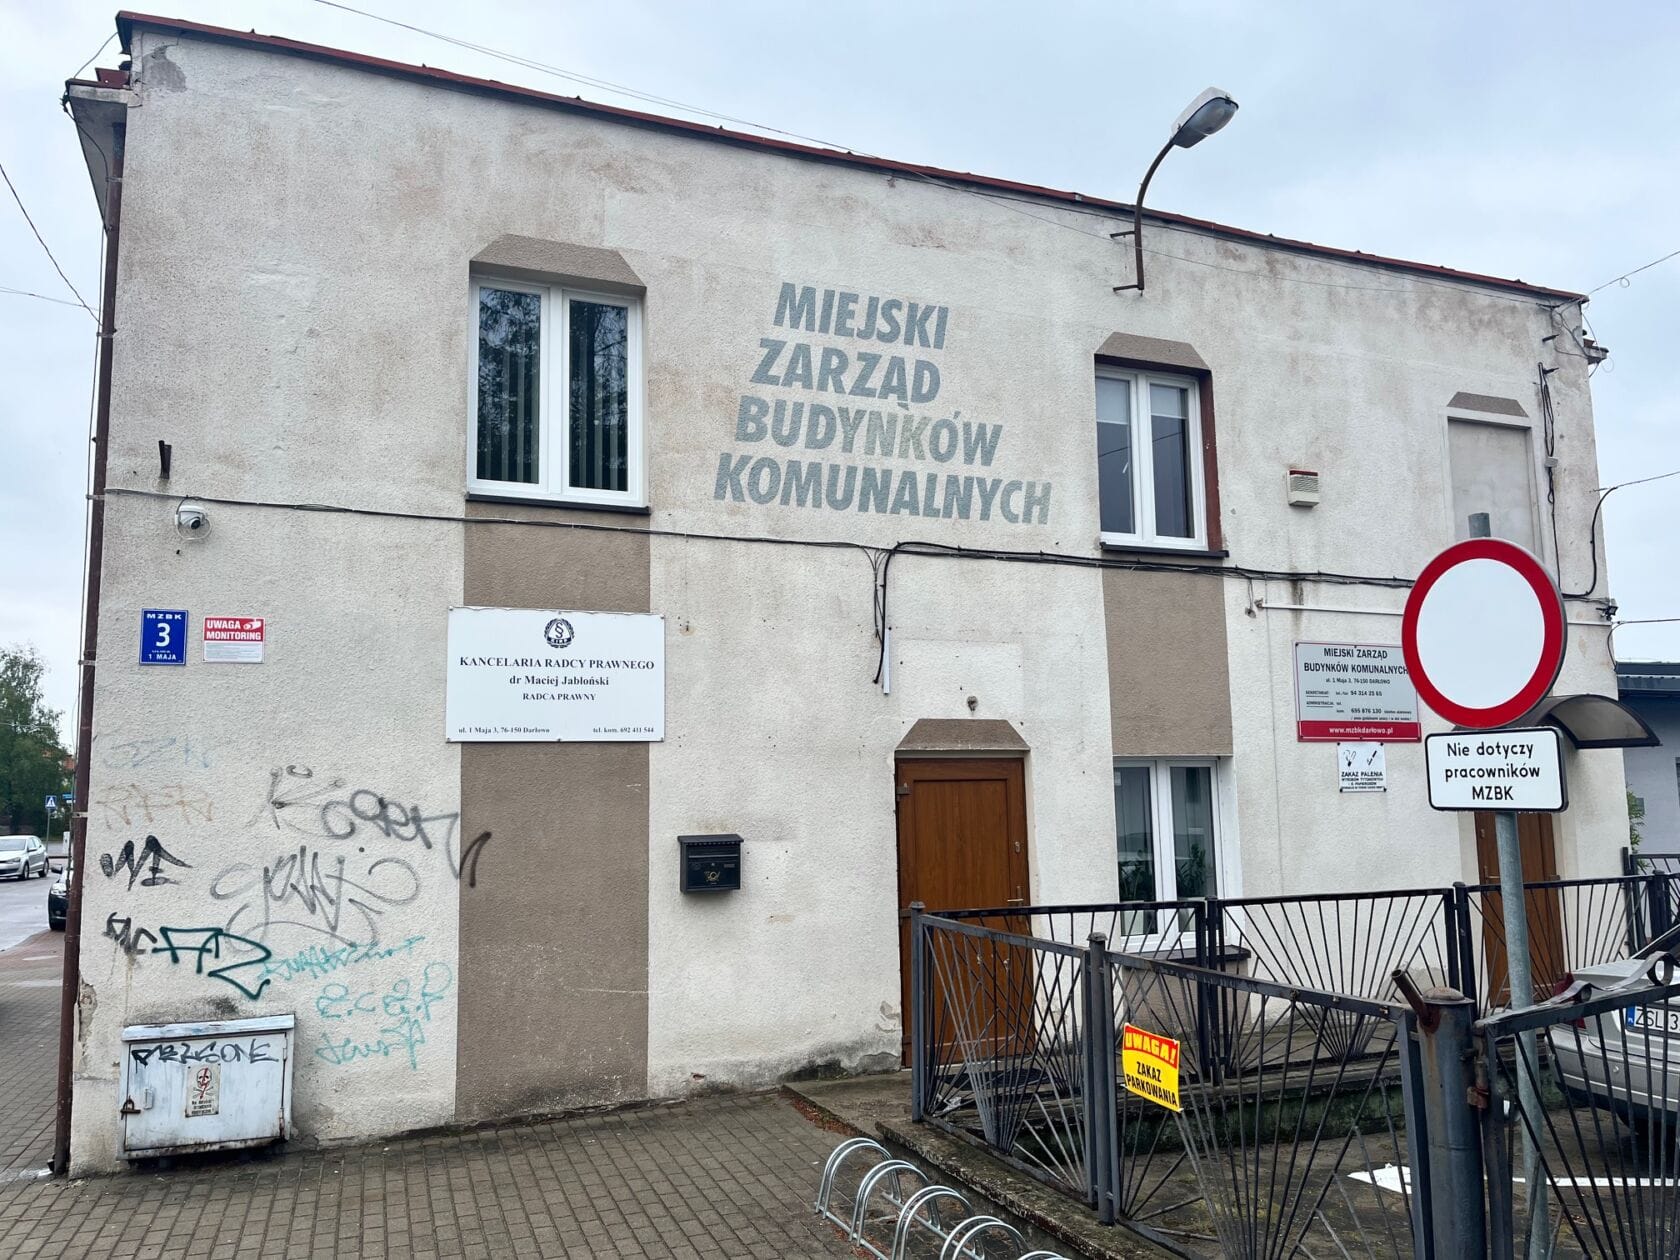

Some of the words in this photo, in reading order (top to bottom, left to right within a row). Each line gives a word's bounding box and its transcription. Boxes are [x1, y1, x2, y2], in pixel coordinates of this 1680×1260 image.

[773, 282, 949, 350] MIEJSKI
[749, 337, 941, 411] ZARZĄD
[734, 395, 1003, 467] BUDYNKÓW
[713, 452, 1051, 525] KOMUNALNYCH
[206, 620, 241, 629] UWAGA
[155, 622, 171, 647] 3
[206, 631, 261, 640] MONITORING
[460, 656, 542, 668] KANCELARIA
[545, 658, 586, 669] RADCY
[589, 659, 655, 670] PRAWNEGO
[1324, 647, 1354, 658] MIEJSKI
[1356, 649, 1388, 661] ZARZĄD
[1304, 661, 1349, 672] BUDYNKÓW
[1351, 664, 1408, 675] KOMUNALNYCH
[509, 675, 522, 685] dr
[524, 675, 559, 687] Maciej
[522, 692, 555, 701] RADCA
[557, 693, 596, 701] PRAWNY
[475, 727, 492, 735] Maja
[1447, 742, 1470, 757] Nie
[1476, 741, 1534, 759] dotyczy
[1445, 763, 1540, 783] pracowników
[1472, 786, 1514, 801] MZBK
[1635, 1007, 1663, 1029] ZSL
[1670, 1013, 1680, 1031] 3
[1124, 1032, 1177, 1065] UWAGA!
[1136, 1061, 1162, 1083] ZAKAZ
[1125, 1073, 1178, 1107] PARKOWANIA
